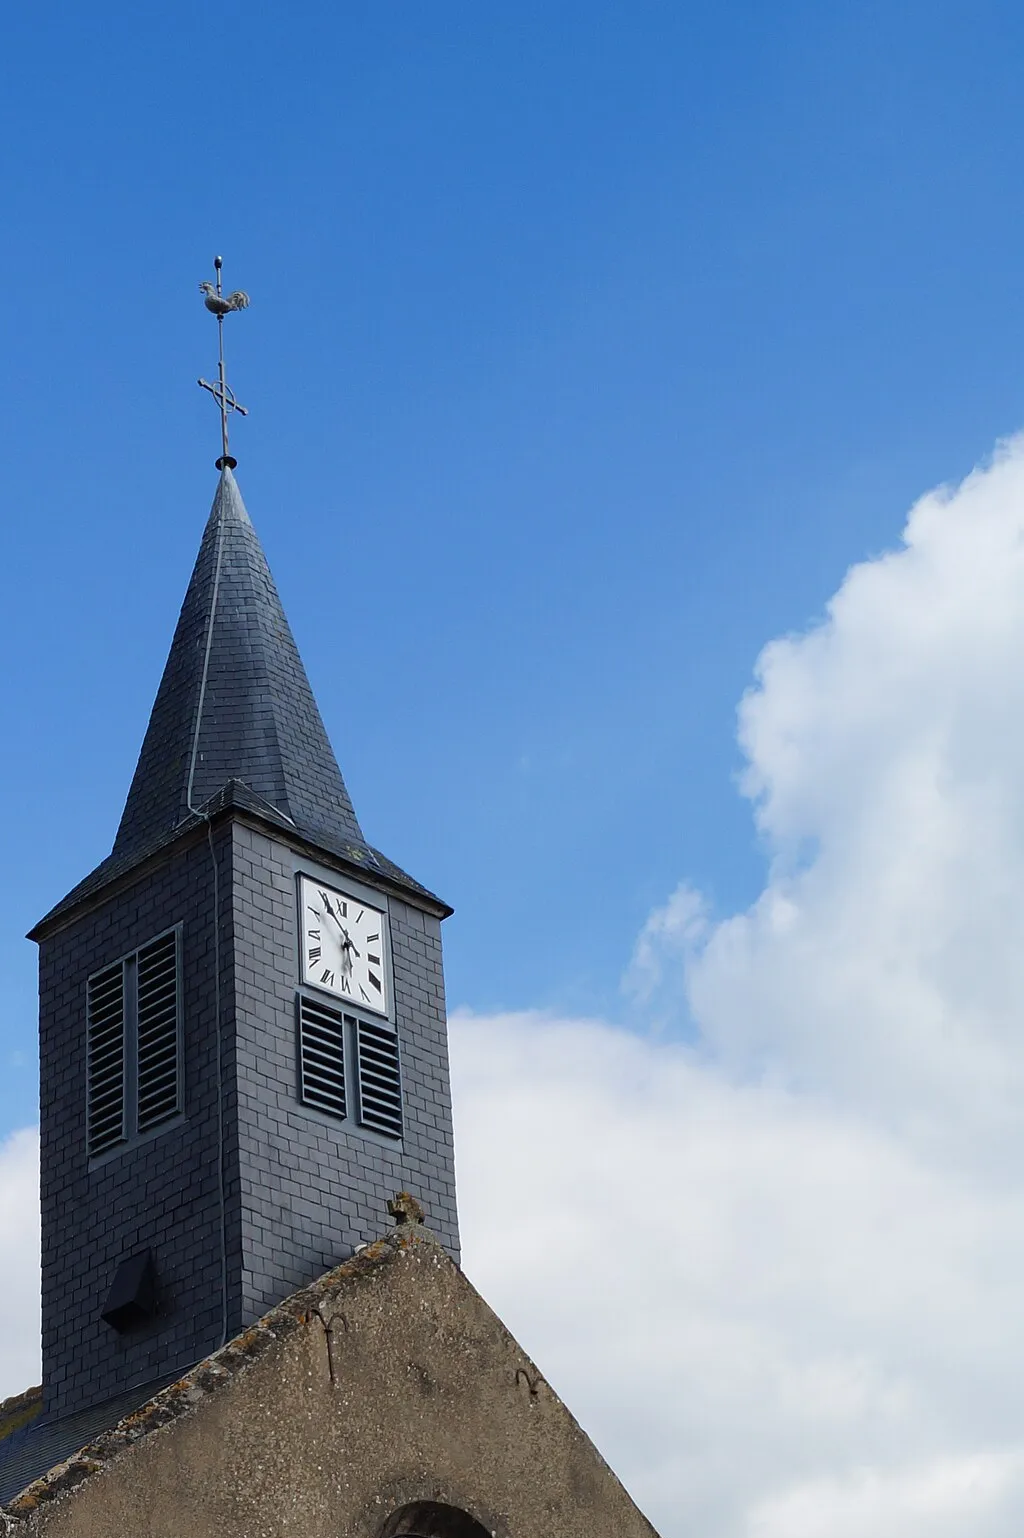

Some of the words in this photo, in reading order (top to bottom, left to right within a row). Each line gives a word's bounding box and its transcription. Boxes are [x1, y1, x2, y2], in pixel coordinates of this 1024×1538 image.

[336, 898, 347, 918] XII
[367, 934, 379, 943] II
[309, 947, 321, 969] VIII
[320, 969, 334, 987] VII
